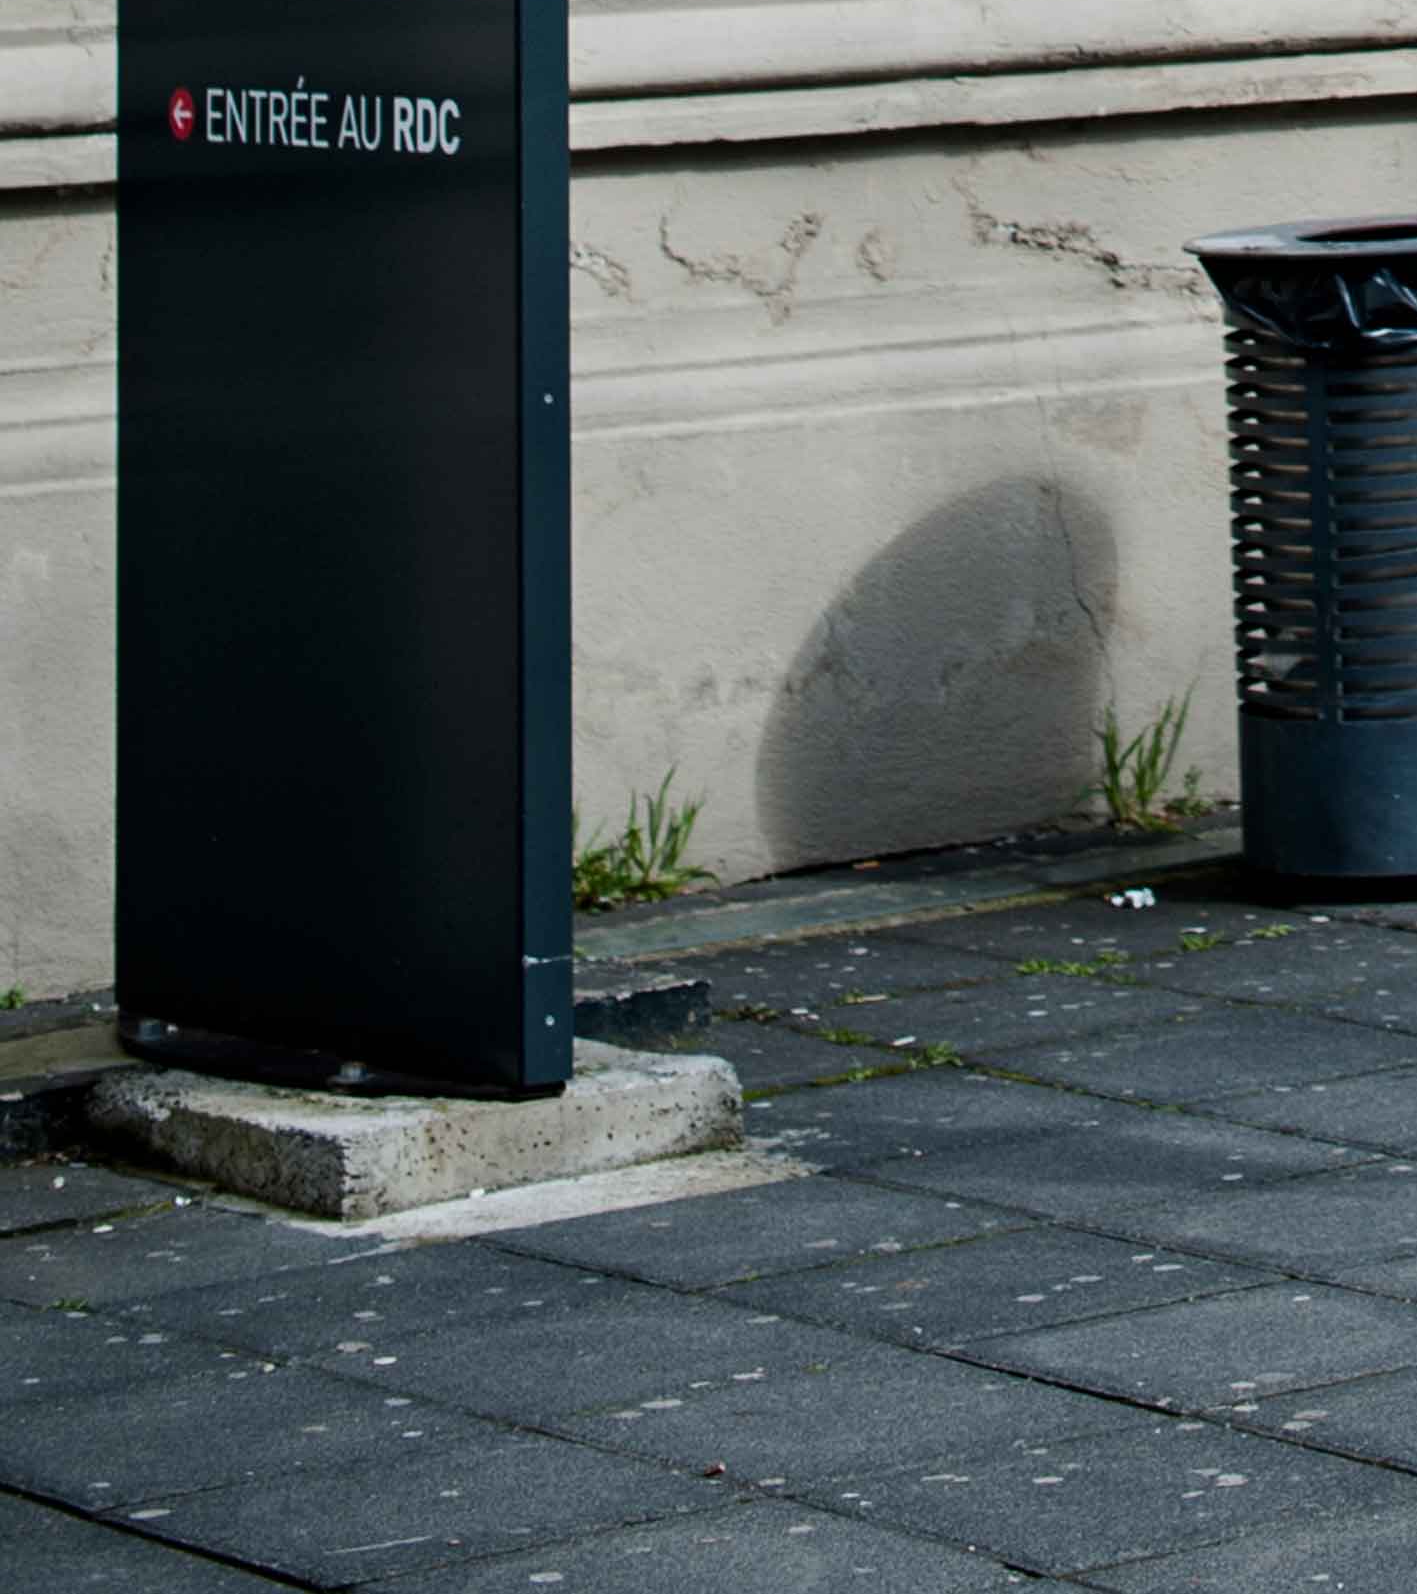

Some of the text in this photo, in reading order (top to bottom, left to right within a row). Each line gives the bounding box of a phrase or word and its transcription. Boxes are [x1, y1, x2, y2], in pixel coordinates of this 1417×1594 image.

[206, 76, 460, 155] ENTRÉE AU RDC
